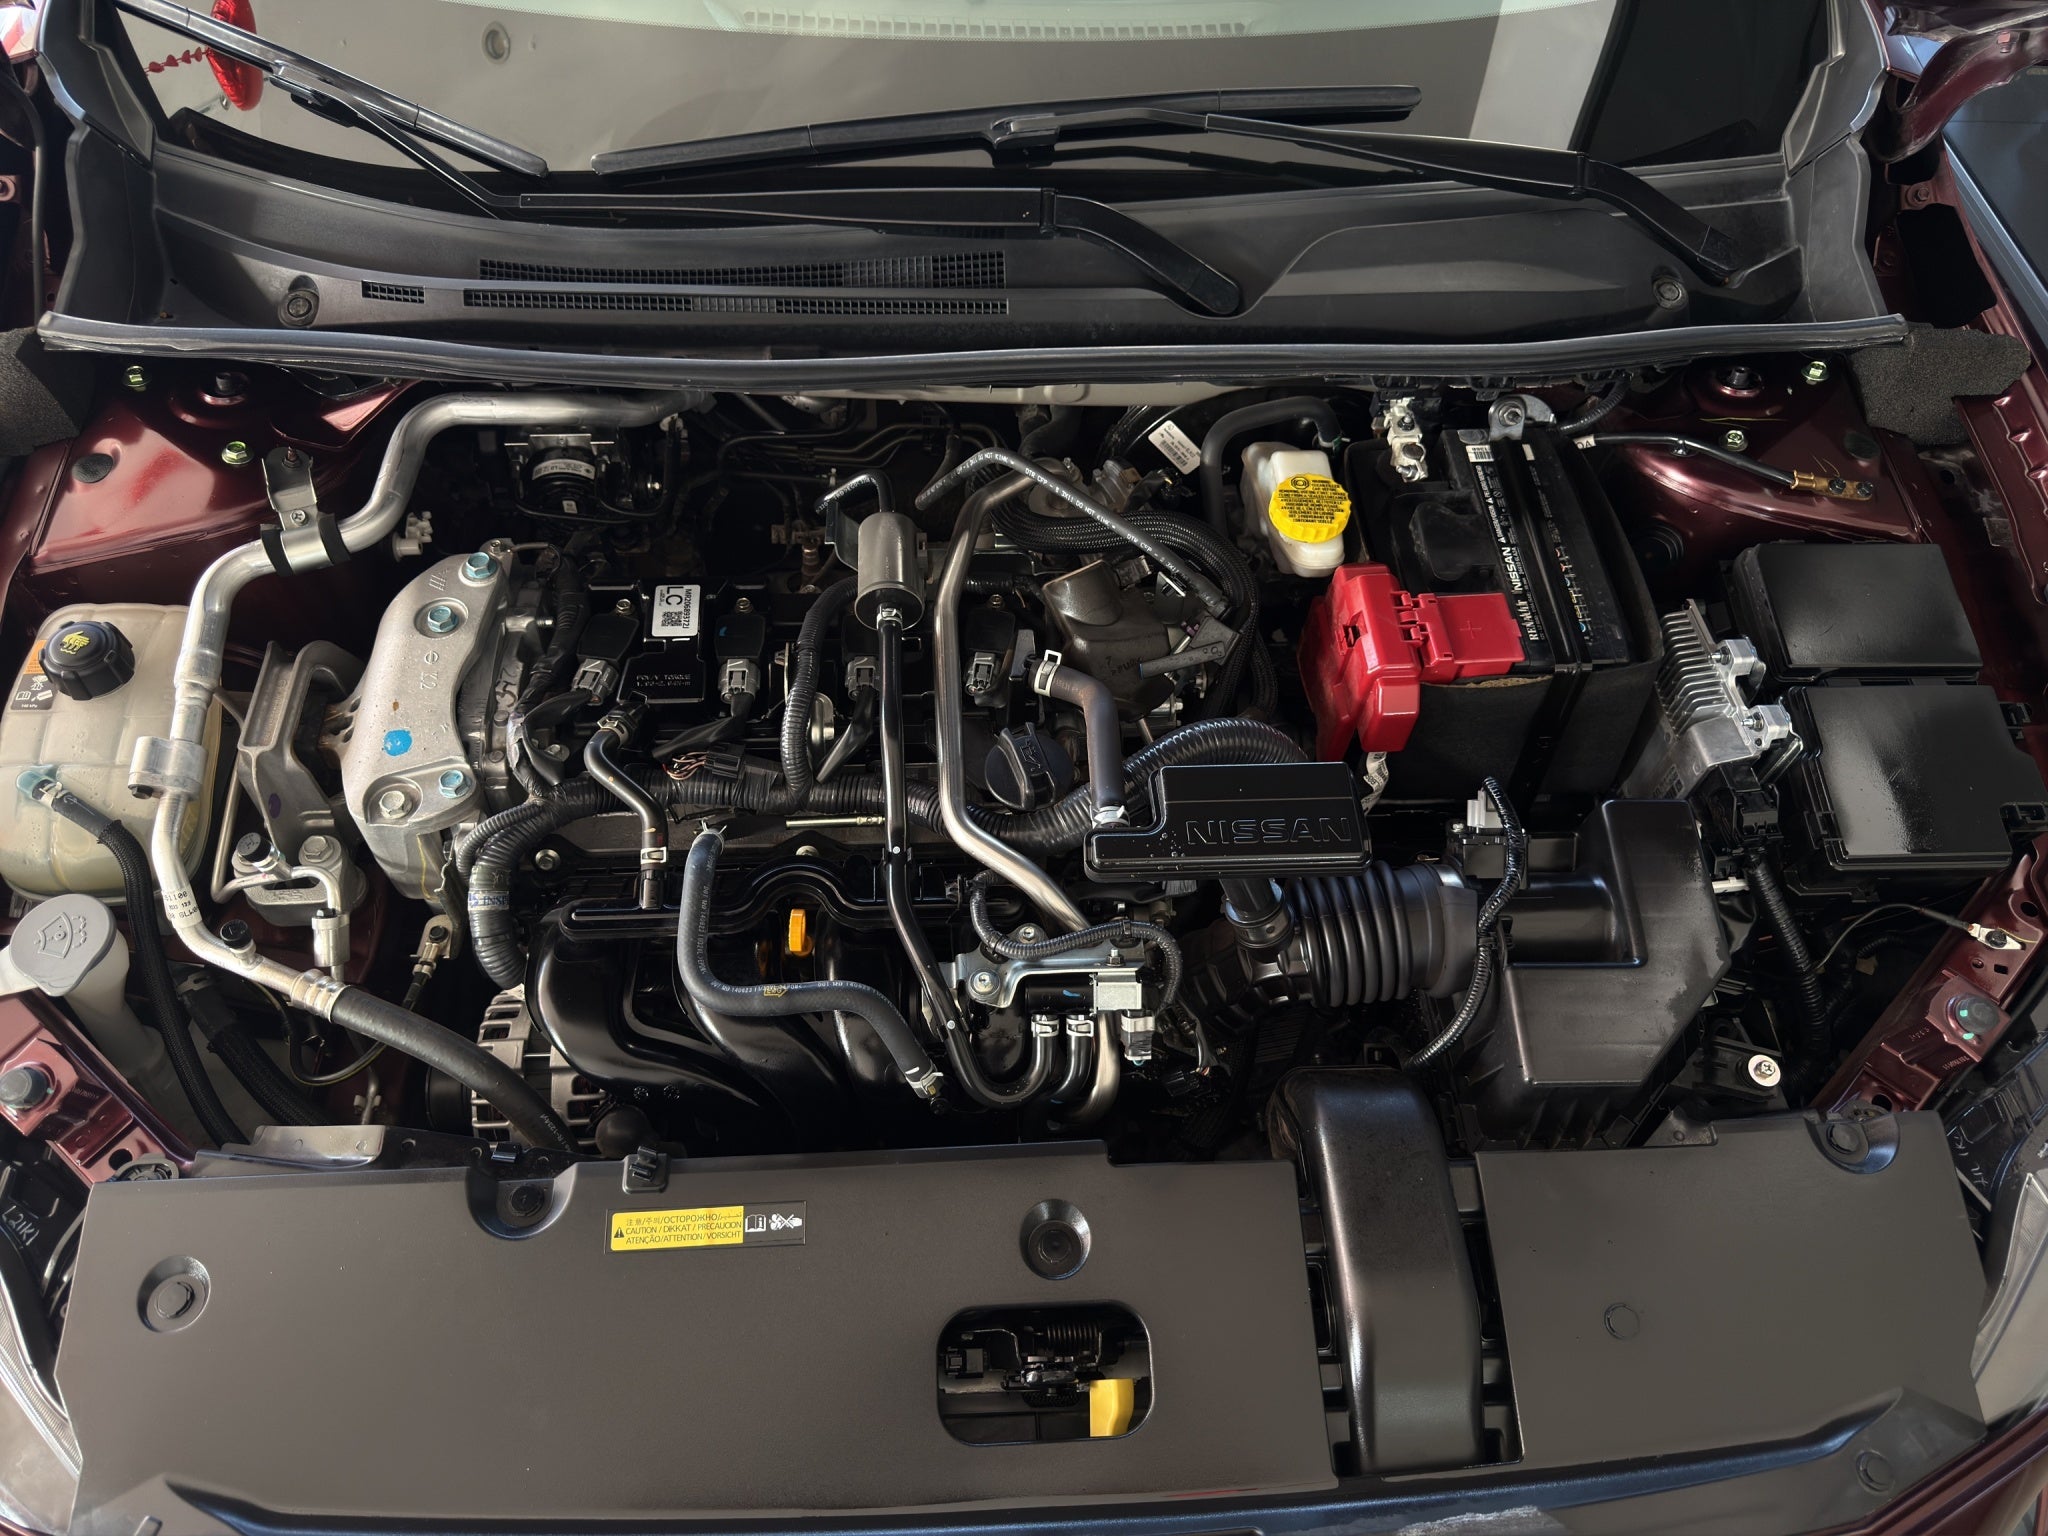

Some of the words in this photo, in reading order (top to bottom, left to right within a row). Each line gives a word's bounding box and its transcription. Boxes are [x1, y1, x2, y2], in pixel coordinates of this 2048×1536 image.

[1501, 546, 1523, 592] NISSAN
[665, 586, 684, 606] LC
[1516, 599, 1539, 641] RENAULT
[1185, 817, 1352, 845] NISSAN
[625, 1226, 657, 1235] CAUTION
[663, 1223, 691, 1233] DIKKAT
